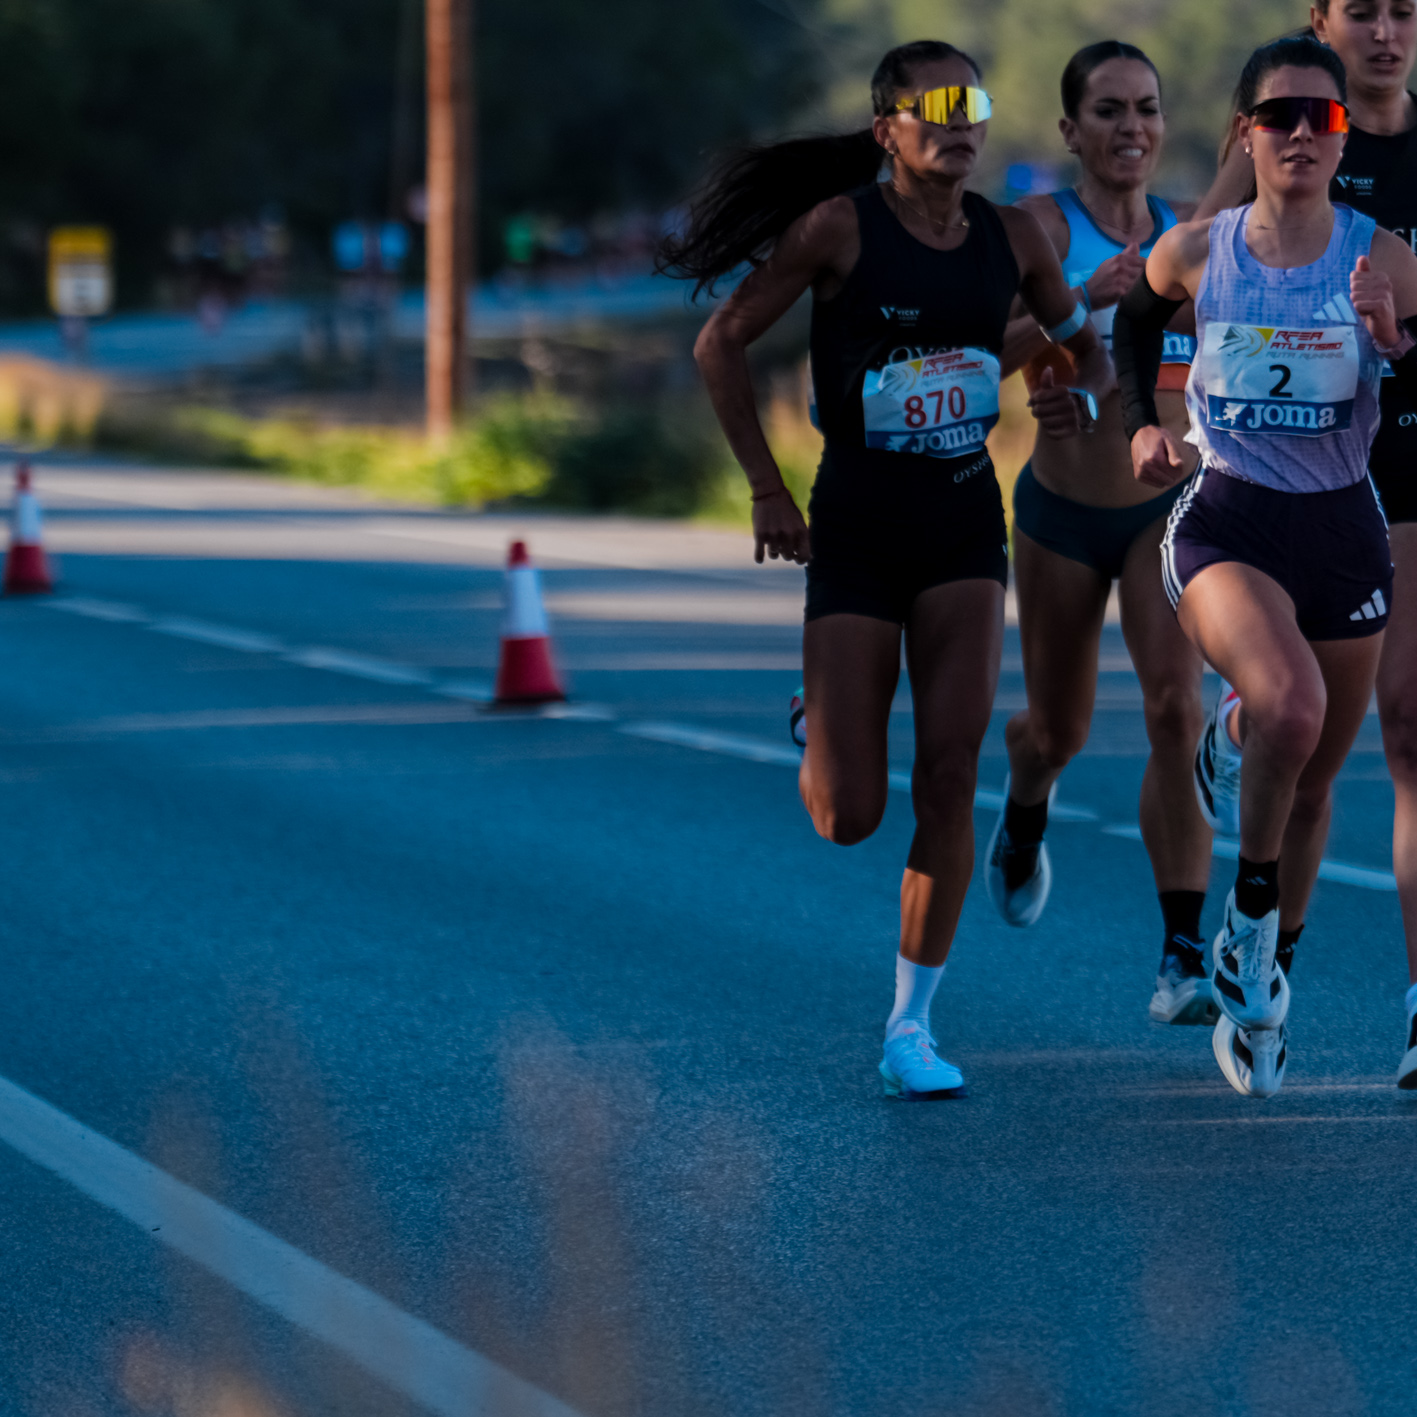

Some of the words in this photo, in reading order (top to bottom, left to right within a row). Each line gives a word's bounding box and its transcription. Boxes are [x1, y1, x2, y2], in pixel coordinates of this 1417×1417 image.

[1270, 342, 1343, 351] ATLETISMO
[1274, 330, 1324, 343] RFEA
[1268, 364, 1293, 398] 2
[904, 386, 967, 429] 870
